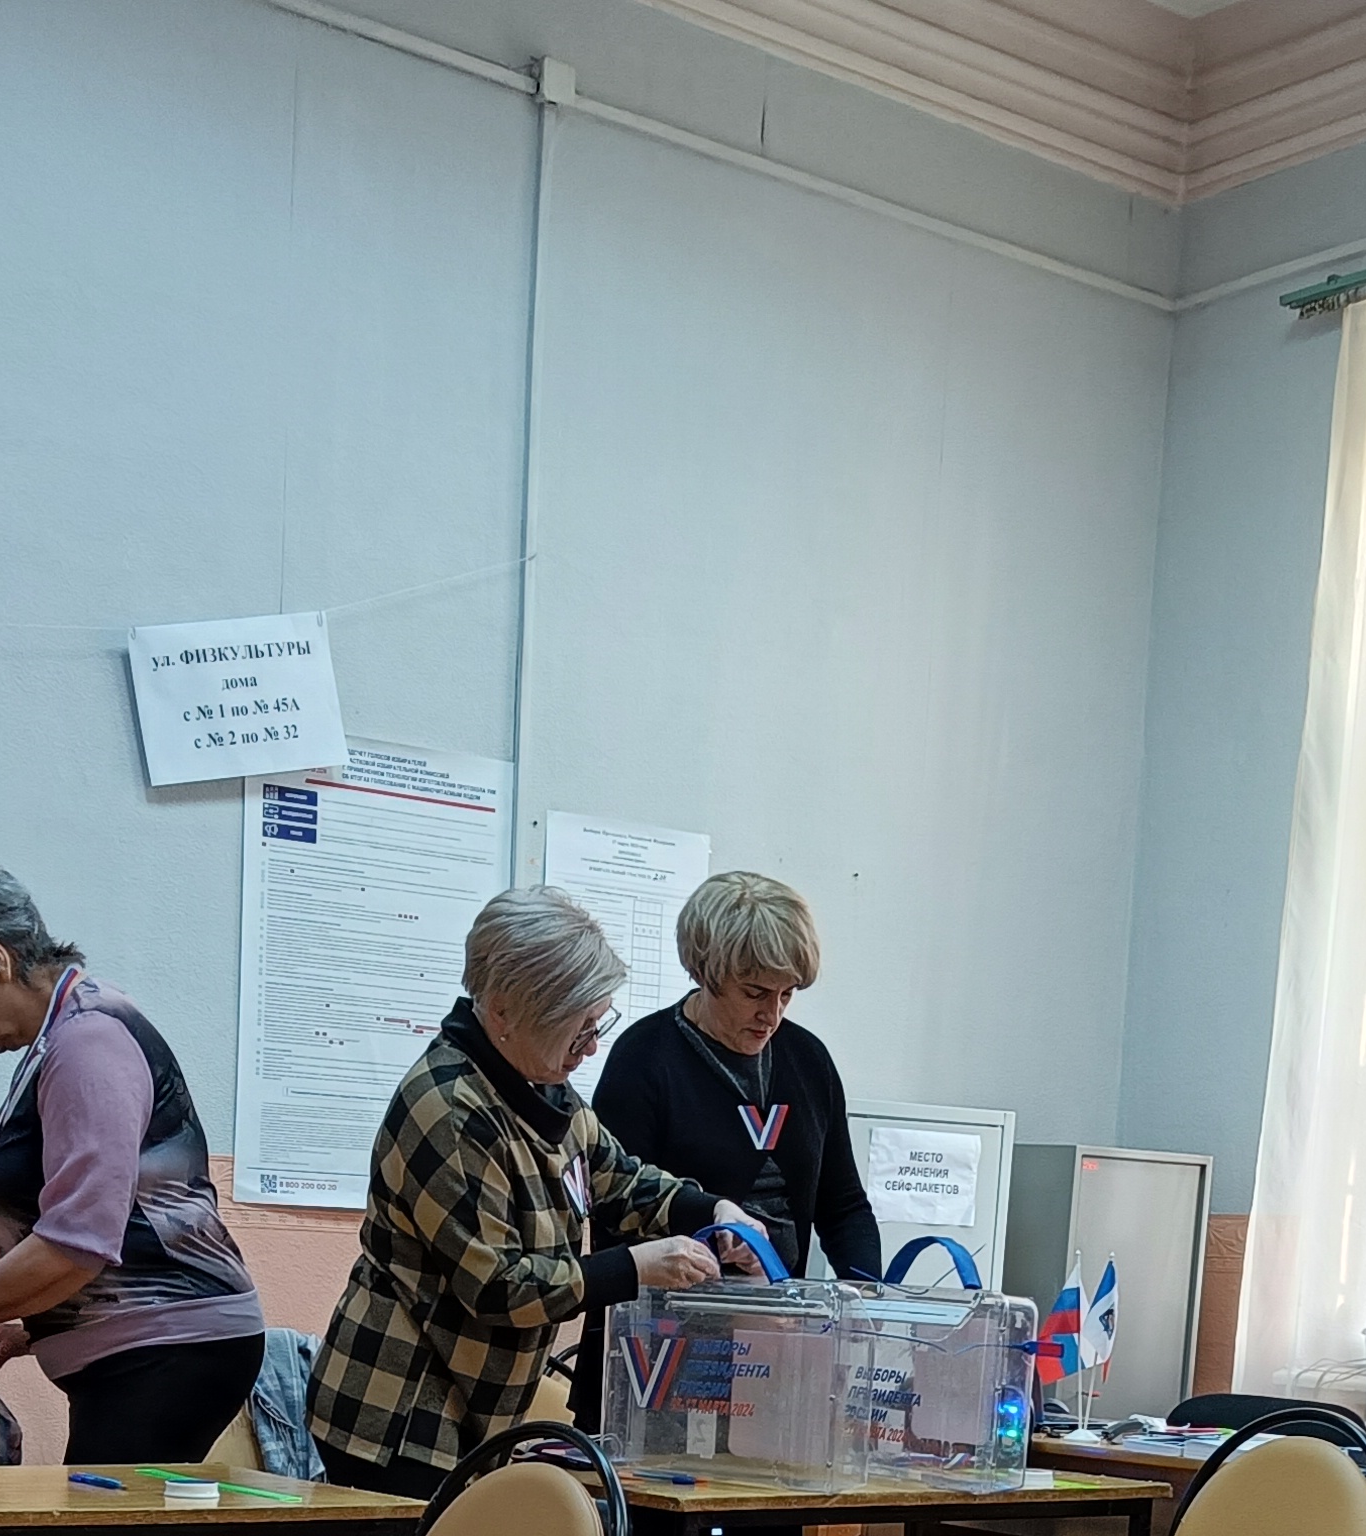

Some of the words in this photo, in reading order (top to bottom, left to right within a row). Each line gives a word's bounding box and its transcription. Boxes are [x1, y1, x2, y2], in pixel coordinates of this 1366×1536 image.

[151, 655, 176, 671] ул.
[179, 640, 312, 665] ФИЗКУЛЬТУРЫ
[220, 675, 258, 692] дома
[182, 711, 191, 722] с
[195, 704, 213, 720] №
[218, 703, 225, 719] 1
[231, 705, 249, 718] по
[252, 699, 269, 715] №
[272, 697, 300, 713] 45А
[193, 738, 202, 749] с
[206, 732, 224, 748] №
[228, 730, 237, 746] 2
[241, 731, 259, 745] по
[262, 726, 279, 742] №
[283, 724, 299, 740] 32
[908, 1150, 944, 1164] МЕСТО
[897, 1166, 950, 1179] ХРАНЕНИЯ
[285, 1181, 300, 1189] 800
[300, 1182, 315, 1190] 200
[884, 1179, 960, 1195] СЕЙФ-ПАКЕТОВ
[692, 1338, 752, 1356] ВЫБОРЫ
[686, 1359, 771, 1379] ПРЕЗИДЕНТА
[855, 1366, 907, 1385] ВЫБОРЫ
[729, 1402, 756, 1417] 2024
